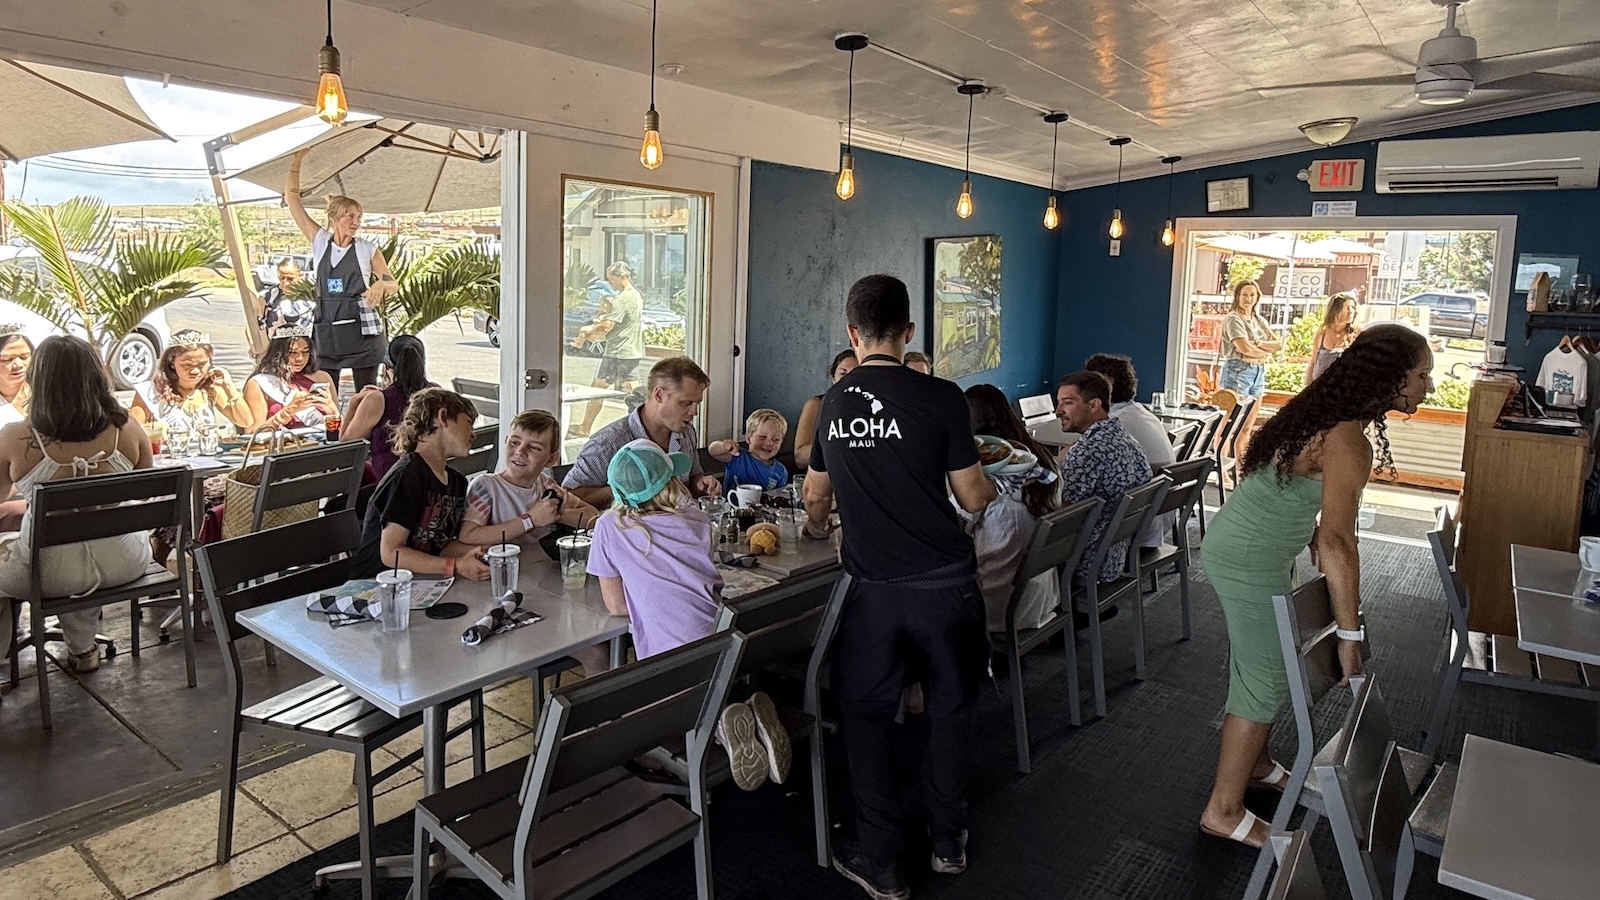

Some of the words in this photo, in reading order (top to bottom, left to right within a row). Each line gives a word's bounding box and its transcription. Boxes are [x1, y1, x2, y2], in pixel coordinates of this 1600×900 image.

[1319, 161, 1357, 186] EXIT
[1382, 263, 1414, 271] DEK
[1278, 286, 1320, 297] DECK
[827, 417, 903, 441] ALOHA
[849, 440, 876, 448] MAUI
